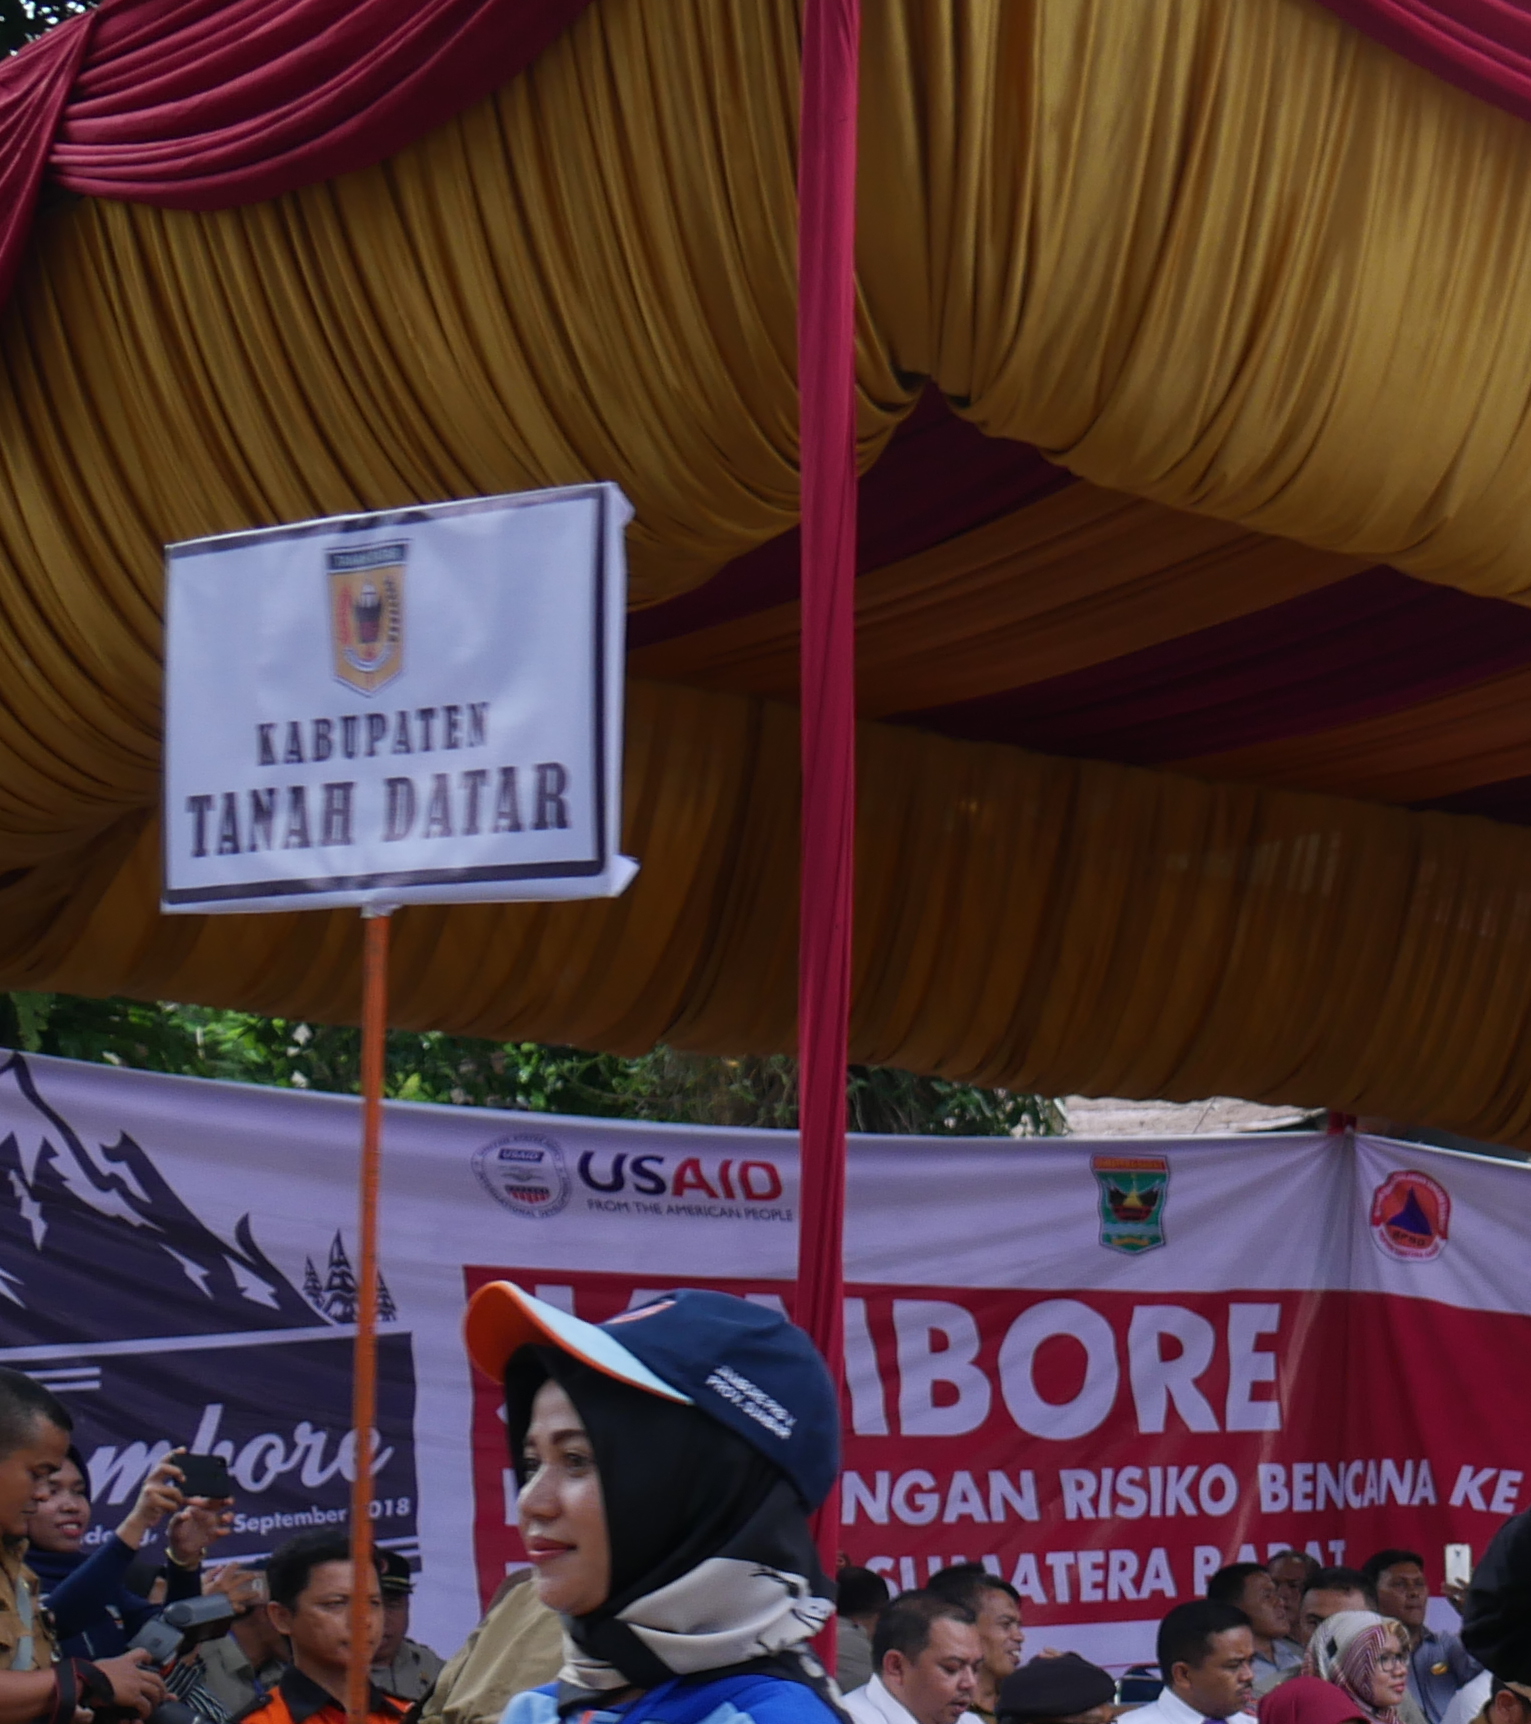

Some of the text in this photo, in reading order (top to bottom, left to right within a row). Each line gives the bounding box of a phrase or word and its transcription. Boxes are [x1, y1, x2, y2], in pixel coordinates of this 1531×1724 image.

[256, 702, 491, 767] KABUPATEN
[185, 761, 573, 859] TANAH DATAR
[577, 1149, 783, 1202] USAID
[587, 1198, 794, 1223] FROM THE AMERICAN PEOPLE
[233, 1497, 412, 1536] September 018
[1061, 1462, 1239, 1520] RISIKO
[1256, 1458, 1438, 1515] BENCANA
[1448, 1463, 1525, 1515] KE
